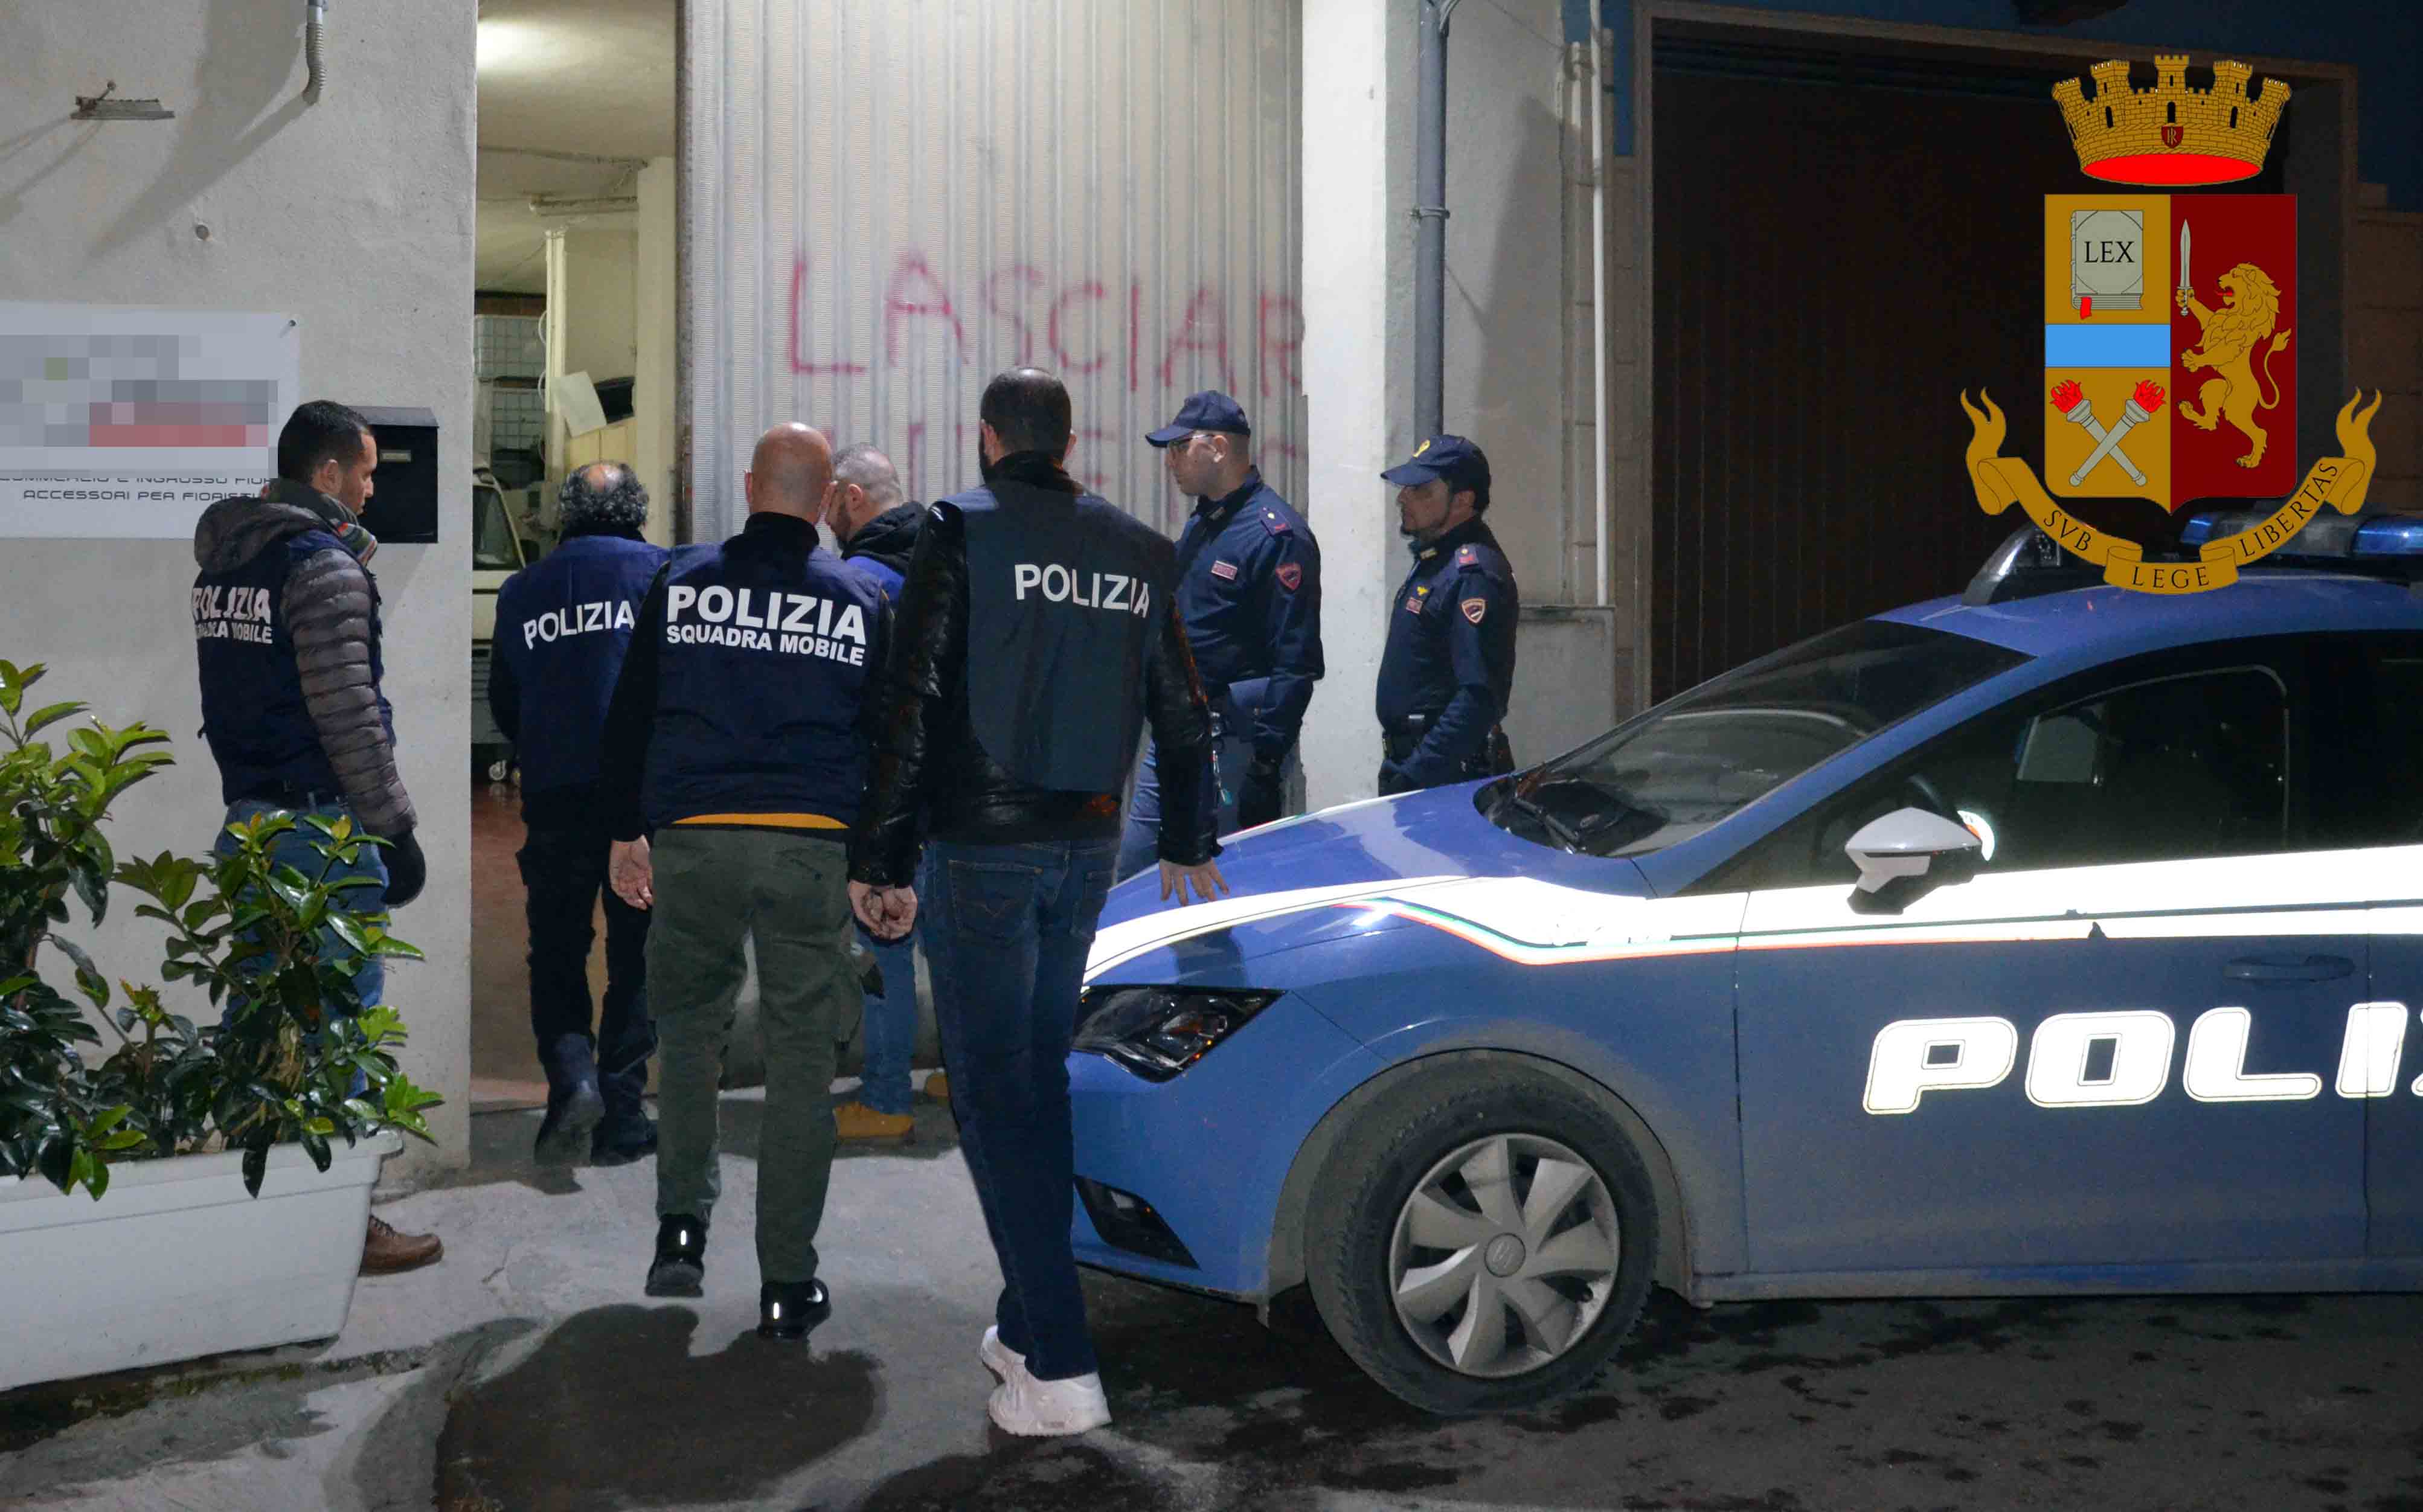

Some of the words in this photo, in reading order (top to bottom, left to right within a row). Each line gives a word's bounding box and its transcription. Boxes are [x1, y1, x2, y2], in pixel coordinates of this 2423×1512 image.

[787, 248, 1303, 399] LASCIAR
[24, 490, 130, 500] ACCESSORI
[137, 491, 175, 501] PER
[193, 585, 271, 624] POLIZIA
[666, 585, 867, 645] POLIZIA
[1014, 563, 1150, 618] POLIZIA
[523, 601, 635, 650] POLIZIA
[666, 624, 772, 651] SQUADRA
[779, 633, 865, 667] MOBILE
[1863, 1001, 2423, 1115] POLI
